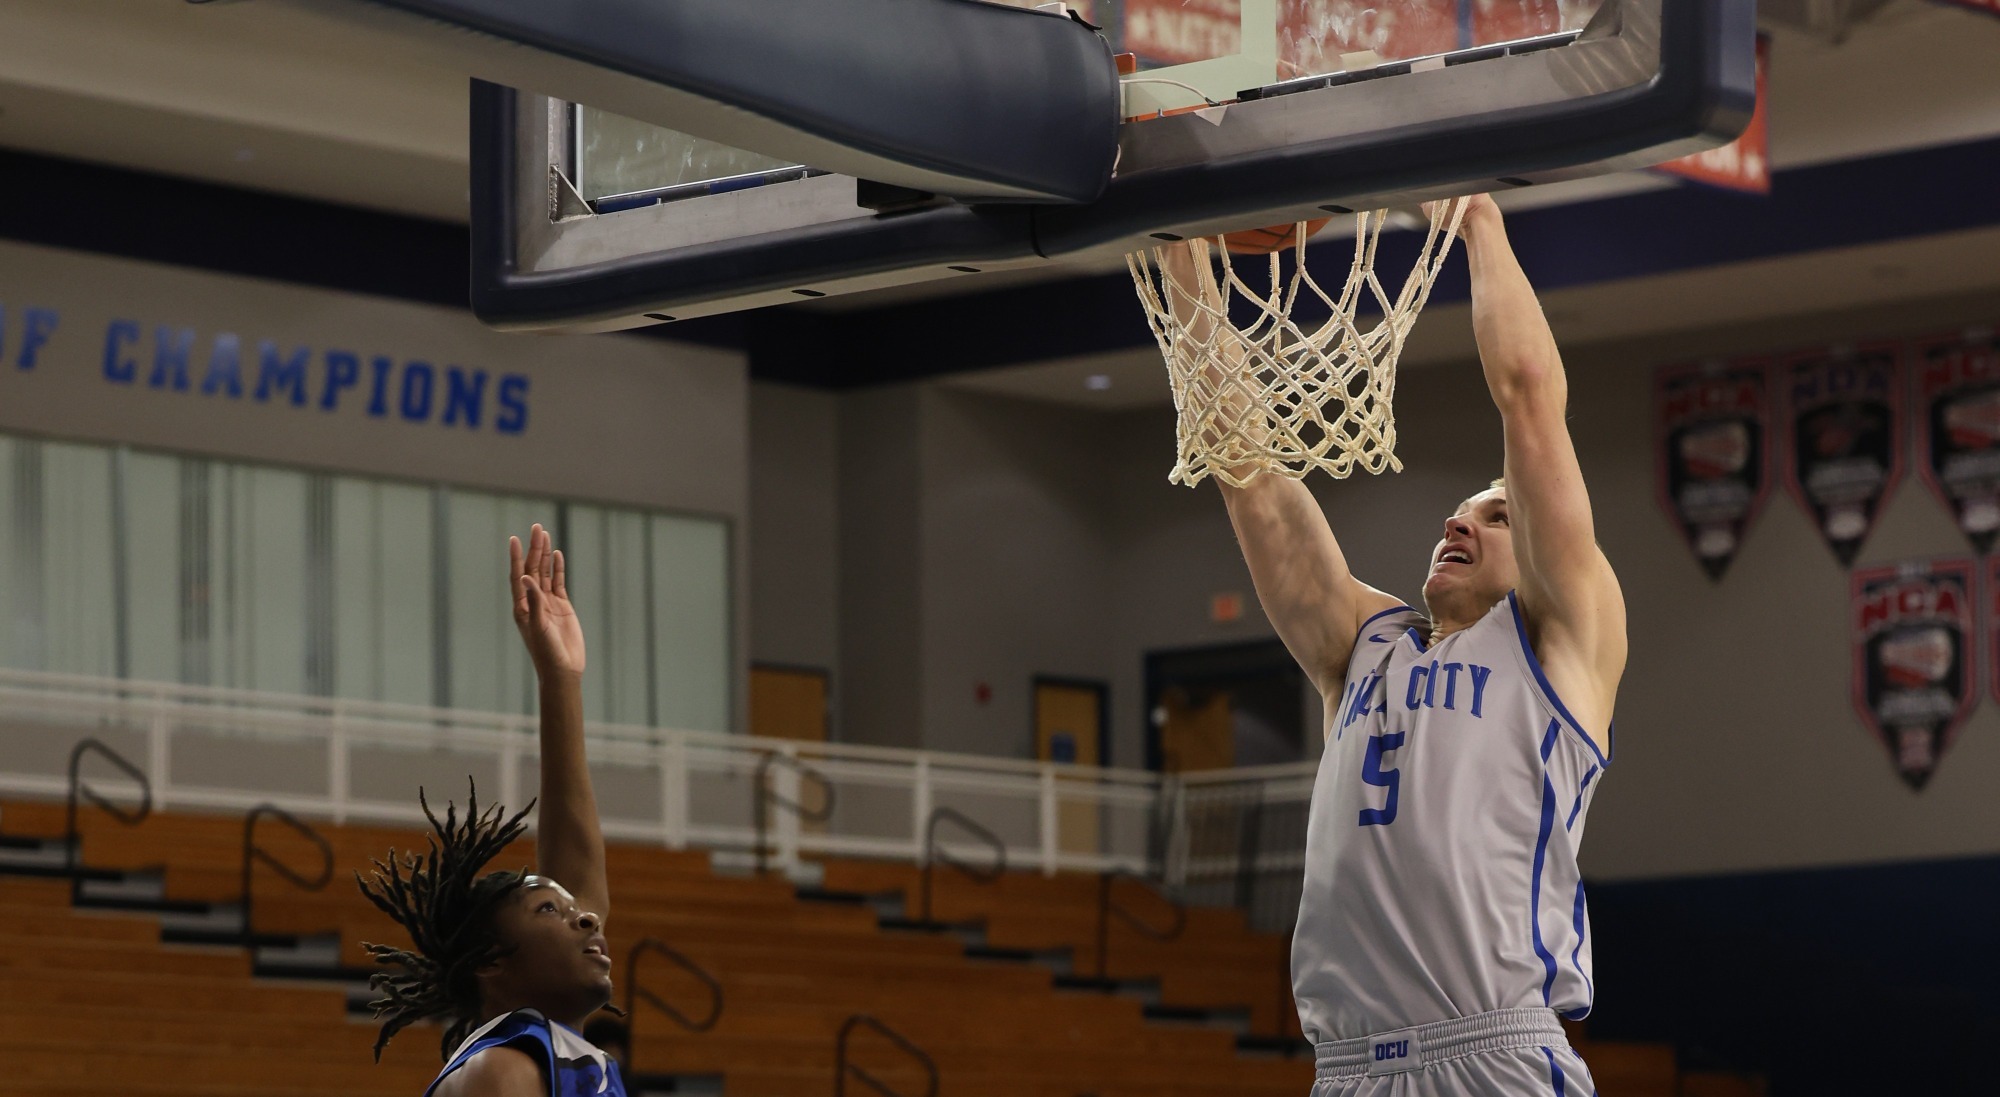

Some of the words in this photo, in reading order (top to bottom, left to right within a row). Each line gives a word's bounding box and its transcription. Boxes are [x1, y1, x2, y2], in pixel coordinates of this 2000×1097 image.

[0, 304, 59, 371] F
[102, 318, 531, 435] CHAMPIONS
[1861, 586, 1958, 629] NCA
[1406, 659, 1492, 718] CITY
[1358, 731, 1405, 827] 5
[1375, 1039, 1409, 1061] OCU
